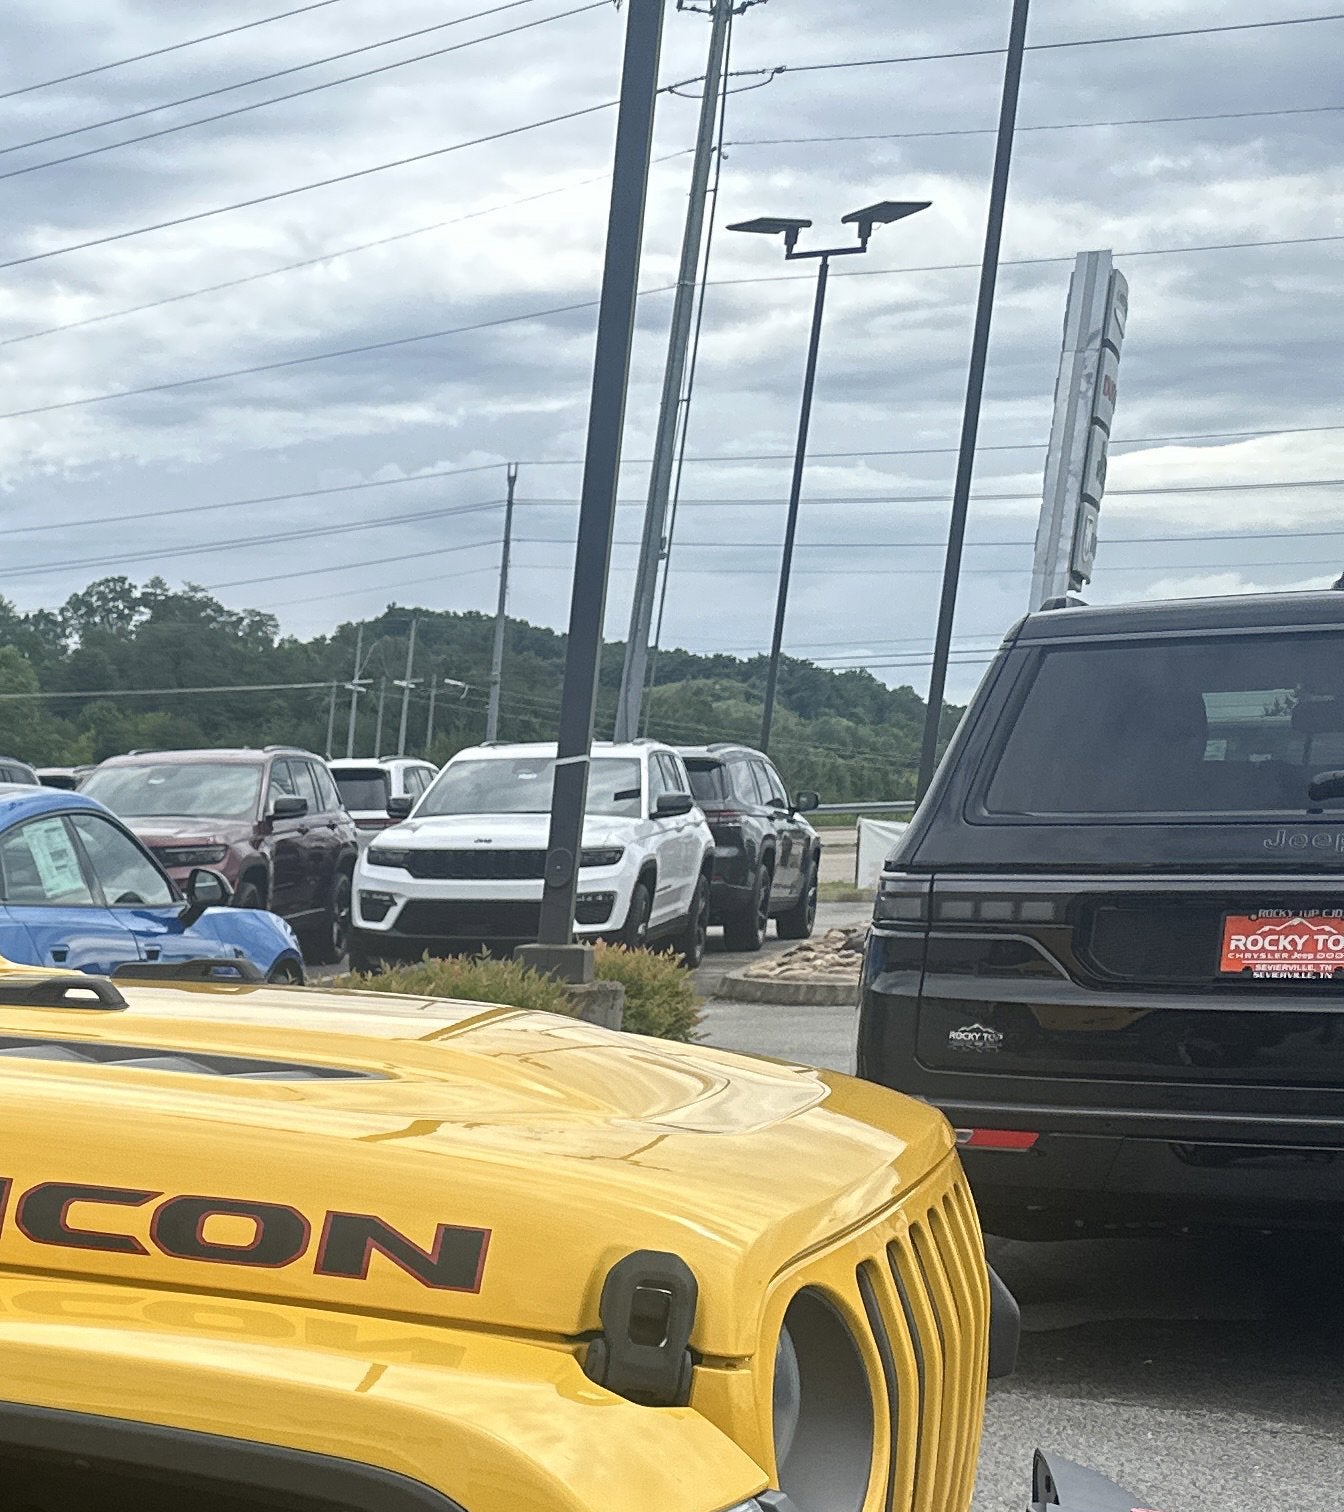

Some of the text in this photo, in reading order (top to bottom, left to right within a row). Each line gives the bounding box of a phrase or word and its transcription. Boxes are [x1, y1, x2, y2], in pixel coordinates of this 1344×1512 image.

[1229, 935, 1310, 950] ROCKY
[1291, 952, 1314, 960] Jeep
[1255, 964, 1332, 972] SEVIERVILLE, TN
[949, 1031, 981, 1040] ROCKY
